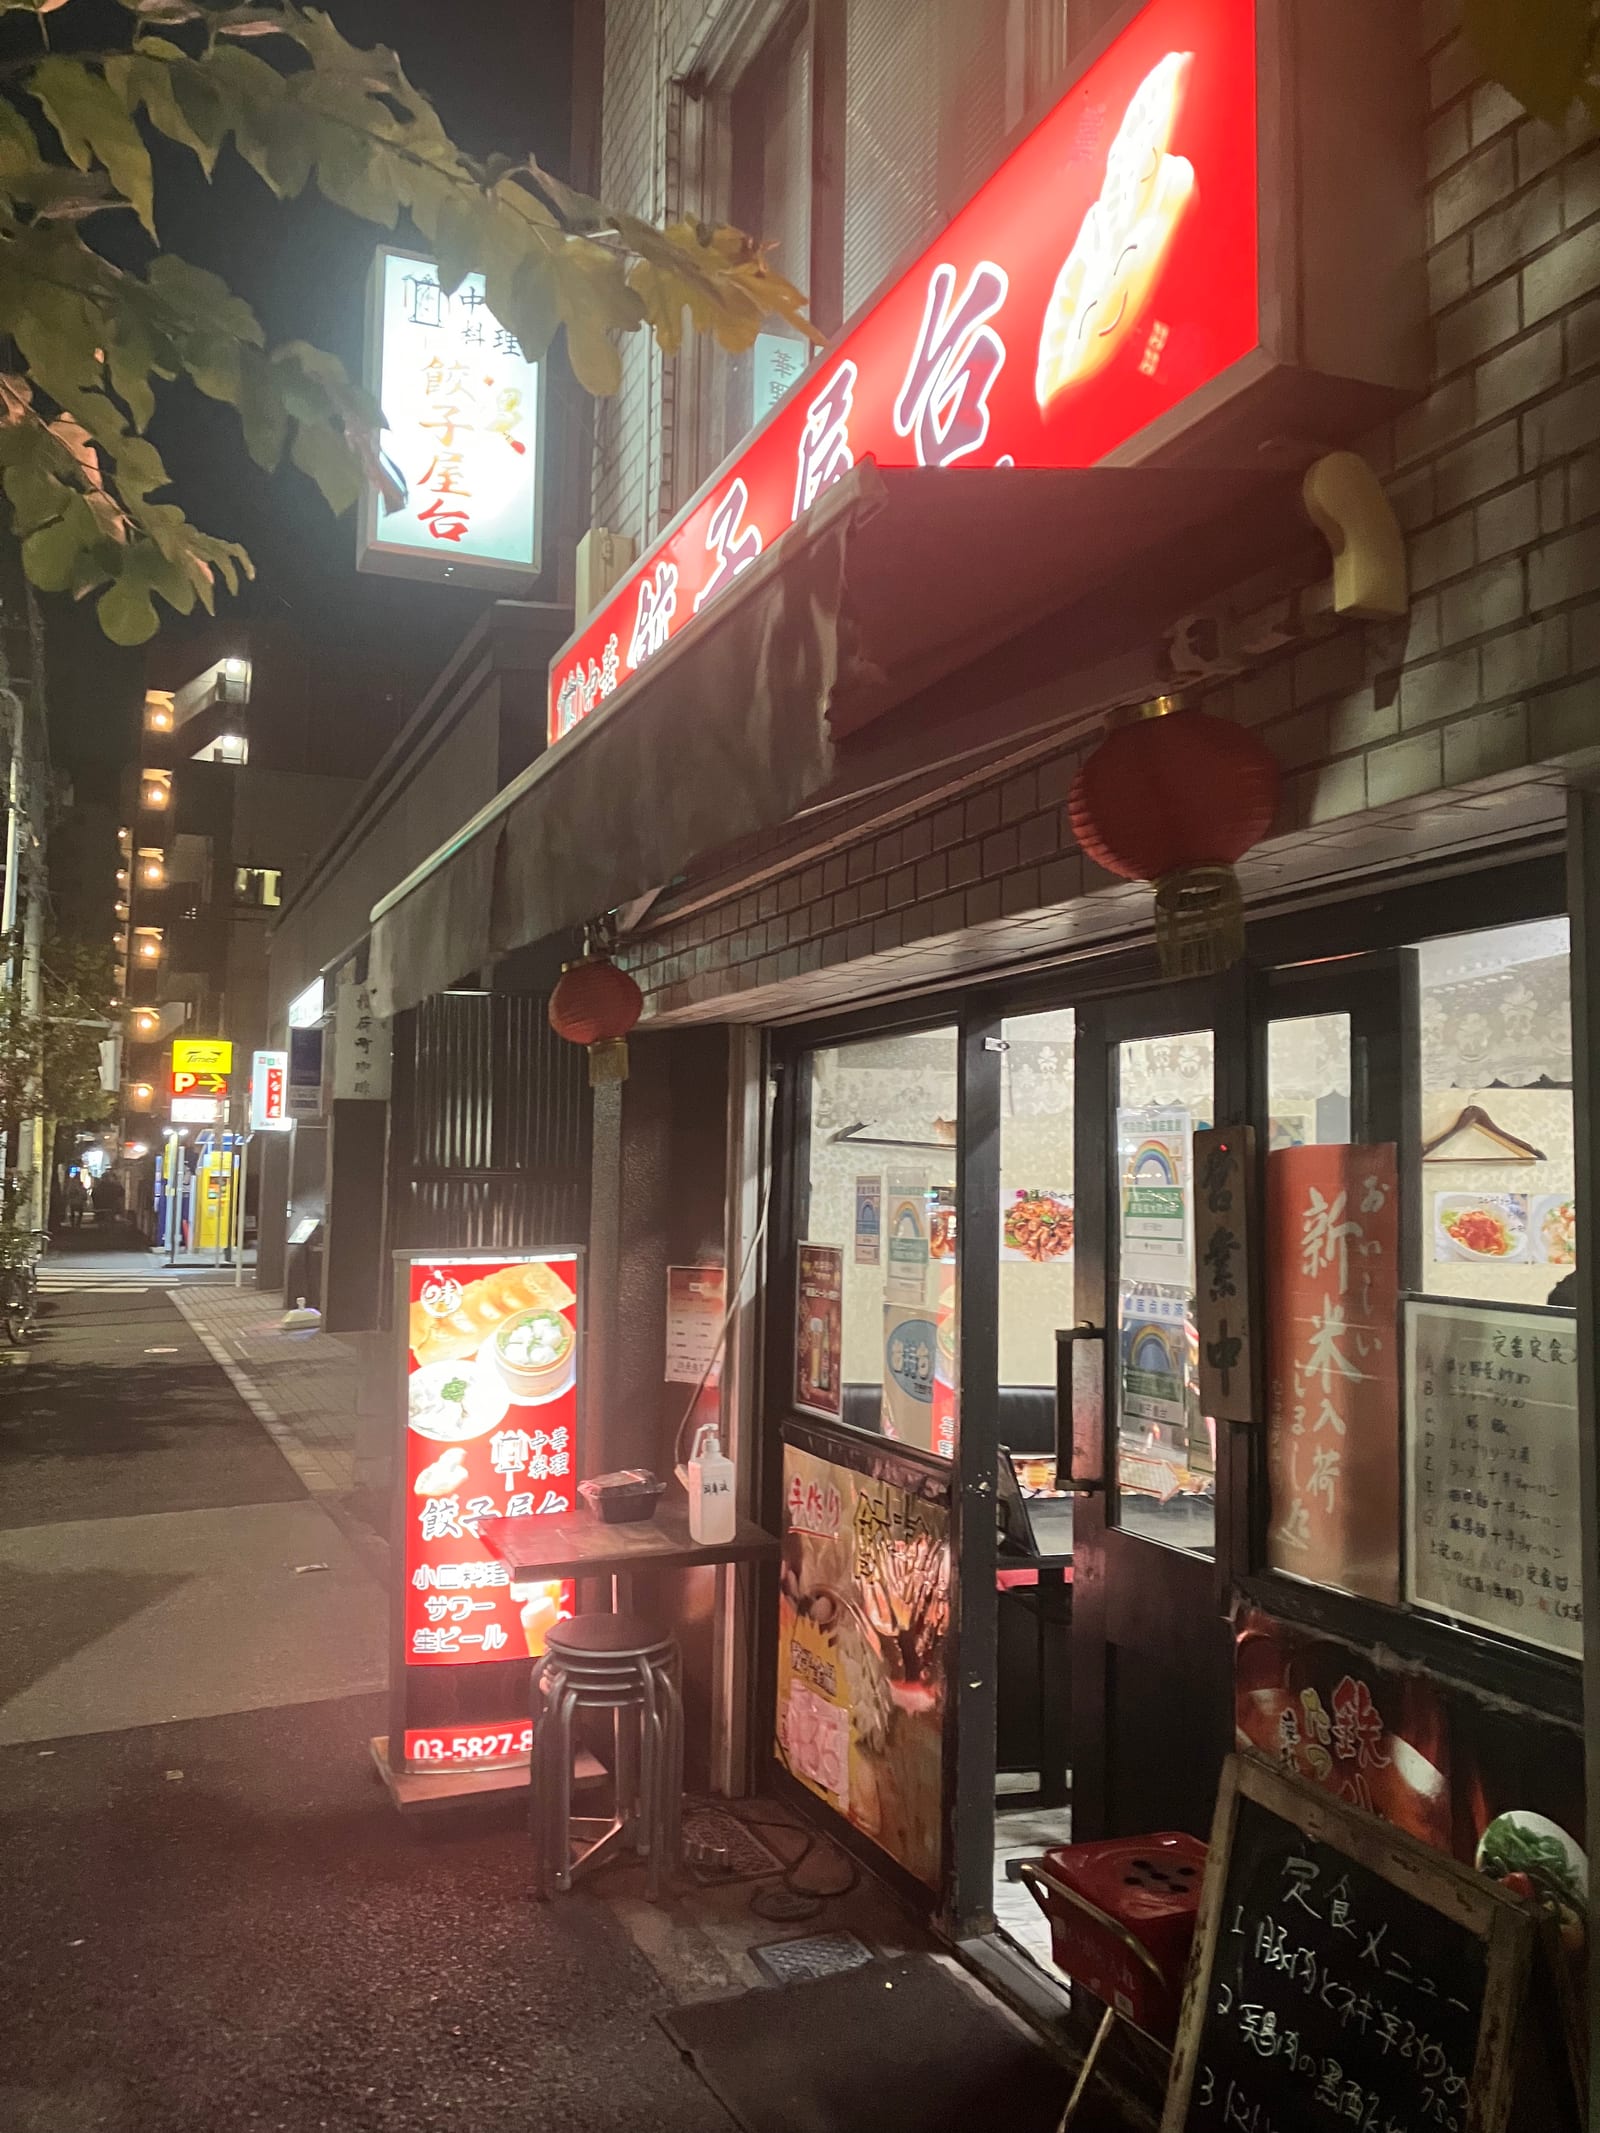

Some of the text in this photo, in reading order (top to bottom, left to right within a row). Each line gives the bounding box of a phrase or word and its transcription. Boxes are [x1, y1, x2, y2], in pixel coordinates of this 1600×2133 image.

[416, 355, 476, 542] 餃子屋台
[187, 1055, 218, 1064] Times
[174, 1072, 197, 1093] P
[1202, 1146, 1241, 1398] 営業中
[1355, 1175, 1390, 1358] おいしい
[1300, 1185, 1363, 1515] 新米入荷
[529, 1426, 570, 1456] 中華
[424, 1595, 496, 1622] サワー
[412, 1624, 508, 1654] 生ビール
[1280, 1845, 1471, 2013] 定食メニュー
[1217, 1983, 1233, 2015] 2
[1199, 2066, 1215, 2107] 3
